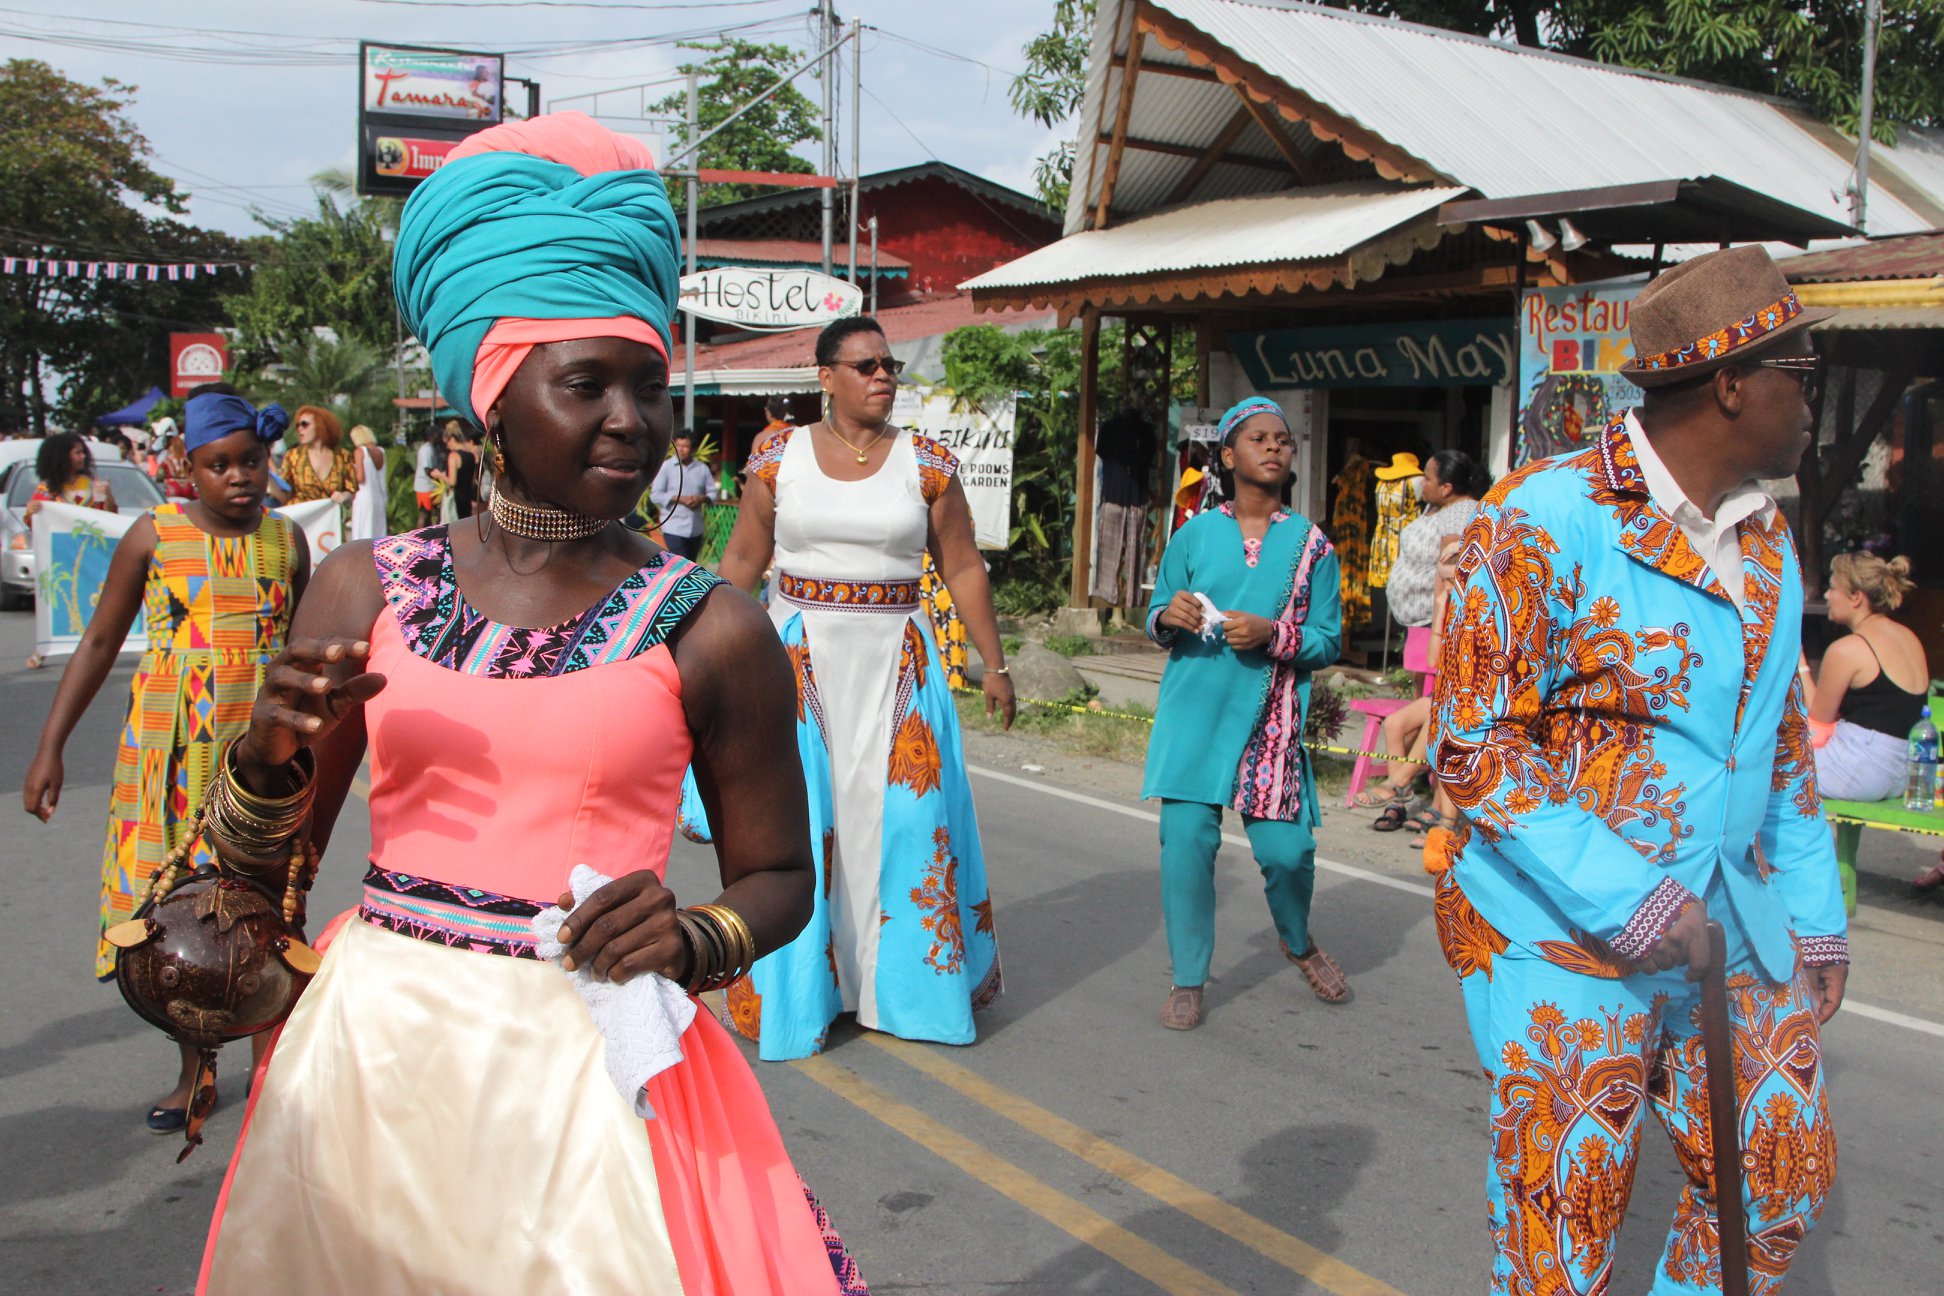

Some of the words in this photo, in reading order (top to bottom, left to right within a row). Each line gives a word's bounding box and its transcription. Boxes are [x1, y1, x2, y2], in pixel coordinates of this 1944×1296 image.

[375, 68, 467, 107] Tamara
[701, 273, 820, 312] Hostel
[1522, 290, 1630, 355] Restau
[1255, 334, 1388, 383] Luna
[1396, 334, 1512, 386] May
[1552, 338, 1632, 372] BIK
[938, 428, 1011, 450] BIKINI
[962, 477, 1008, 488] GARDEN
[970, 463, 1010, 475] ROOMS
